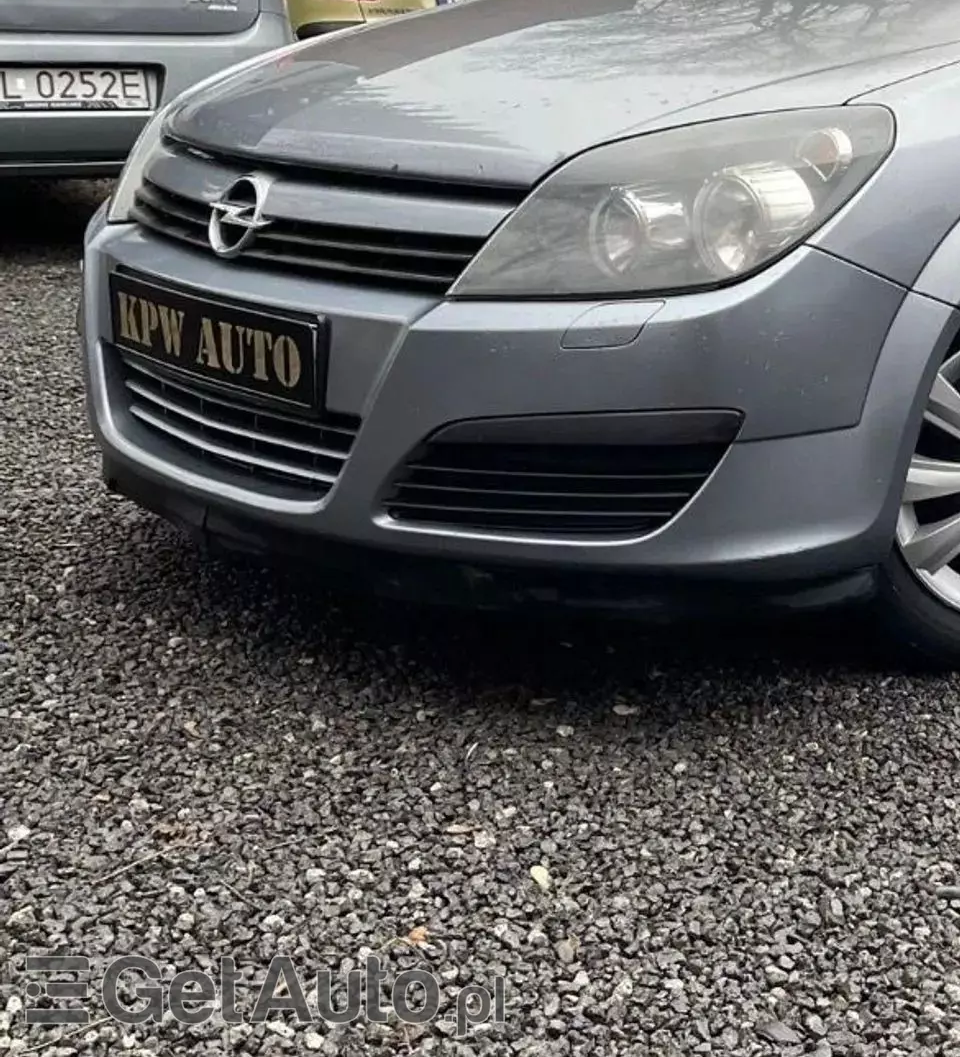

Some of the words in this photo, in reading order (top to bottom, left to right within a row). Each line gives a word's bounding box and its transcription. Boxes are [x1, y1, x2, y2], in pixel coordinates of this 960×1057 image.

[36, 70, 141, 99] 0252E
[117, 292, 185, 357] KPW
[196, 316, 301, 388] AUTO
